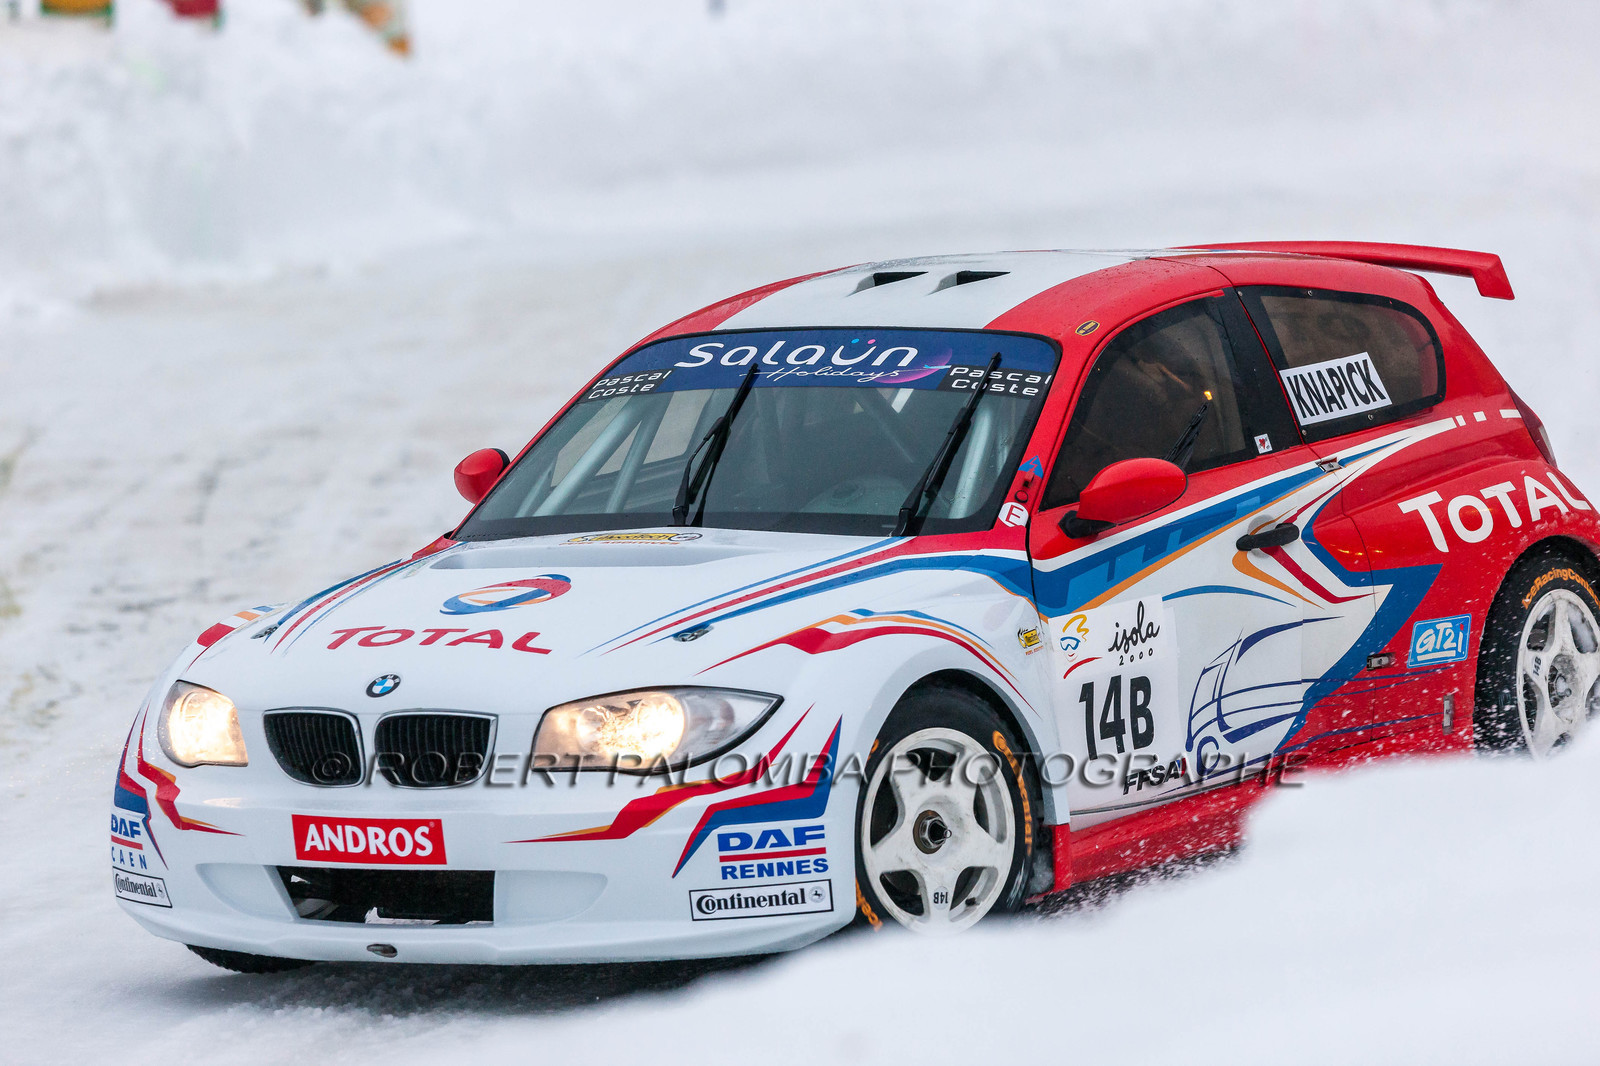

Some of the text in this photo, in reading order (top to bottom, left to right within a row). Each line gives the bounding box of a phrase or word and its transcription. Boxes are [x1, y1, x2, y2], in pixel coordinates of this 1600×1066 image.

[674, 338, 919, 368] Salaün
[592, 370, 672, 389] Pascal
[739, 366, 900, 382] Holidays
[949, 366, 1052, 385] Pascal
[588, 384, 655, 399] Coste
[1286, 359, 1387, 418] KNAPICK
[1397, 472, 1592, 553] TOTAL
[326, 626, 553, 655] TOTAL
[1108, 601, 1160, 654] isola
[1119, 648, 1153, 666] 2000
[1533, 656, 1542, 677] 14B
[1079, 675, 1155, 761] 14B
[1123, 760, 1181, 796] FFSA
[111, 813, 141, 839] DAF
[717, 825, 825, 852] DAF
[304, 823, 434, 857] ANDROS
[111, 846, 147, 870] CAEN
[721, 858, 829, 880] RENNES
[115, 873, 157, 898] Continental
[933, 891, 949, 904] 14B
[696, 888, 807, 915] Continental
